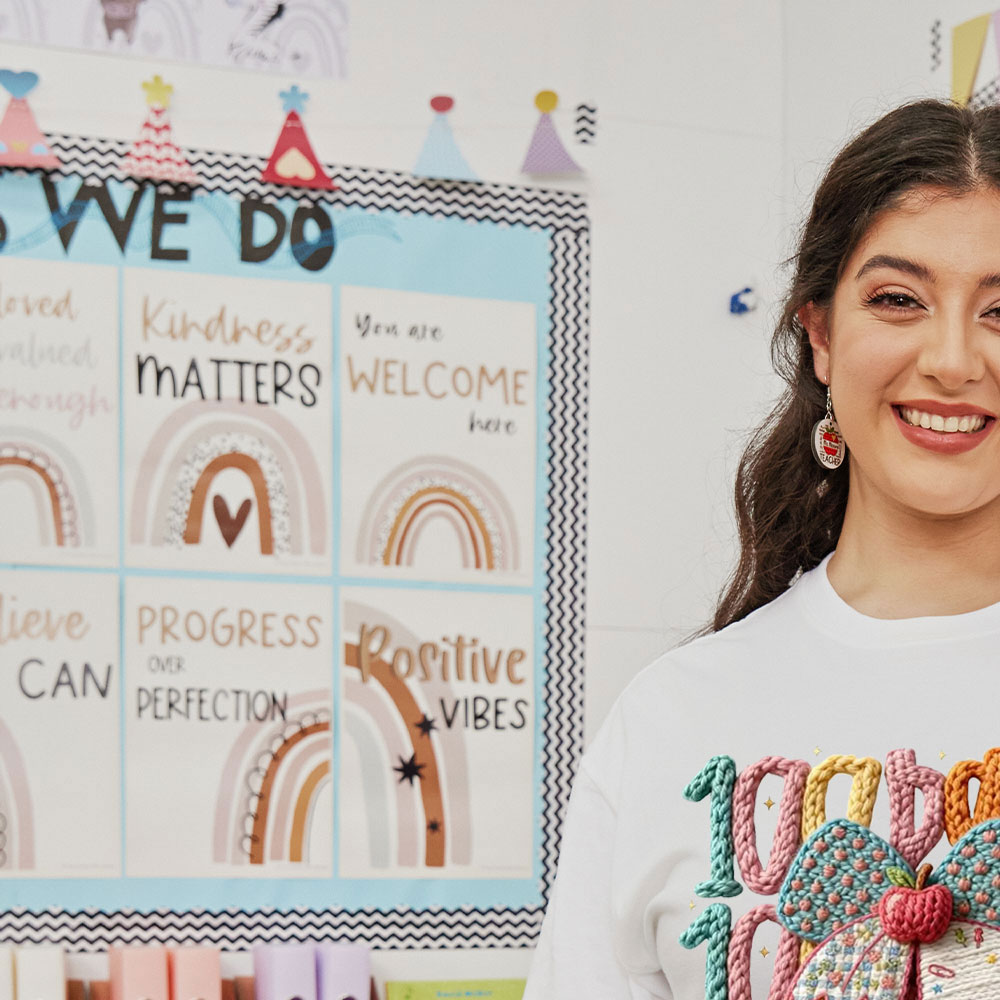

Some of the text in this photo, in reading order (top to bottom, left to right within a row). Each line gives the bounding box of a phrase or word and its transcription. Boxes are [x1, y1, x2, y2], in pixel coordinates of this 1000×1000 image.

[241, 194, 335, 272] DO
[142, 294, 317, 354] Kindness
[355, 313, 444, 341] You are
[347, 354, 529, 405] WELCOME
[469, 409, 517, 435] here
[138, 605, 323, 648] PROGRESS
[148, 655, 186, 674] OVER
[359, 623, 527, 685] Positive
[18, 658, 112, 699] CAN
[137, 687, 289, 722] PERFECTION
[440, 696, 529, 731] VIBES
